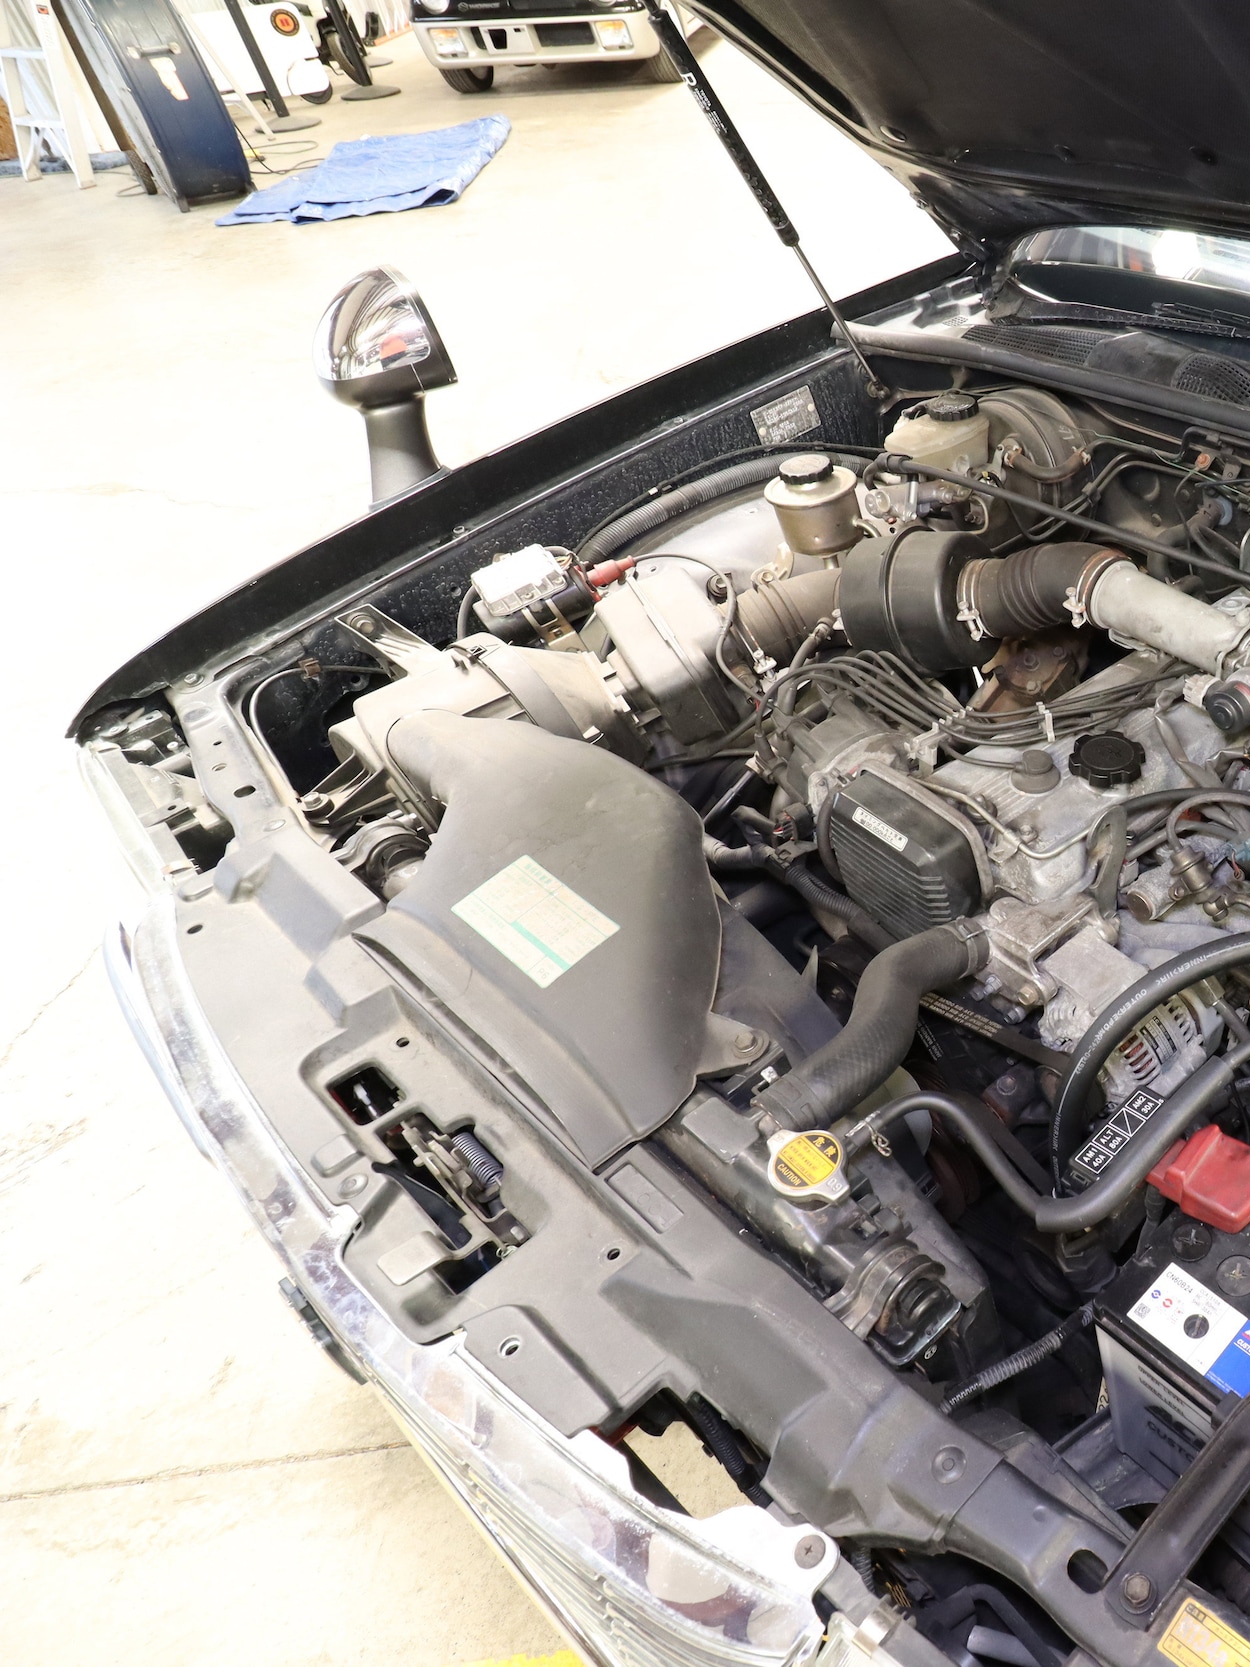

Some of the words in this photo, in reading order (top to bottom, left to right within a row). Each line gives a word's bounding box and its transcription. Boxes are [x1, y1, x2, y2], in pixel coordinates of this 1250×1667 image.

[1132, 1096, 1146, 1109] AM2
[1141, 1102, 1154, 1113] 30A
[1100, 1130, 1114, 1144] ALT
[1108, 1136, 1122, 1149] 80A
[1083, 1148, 1098, 1163] AM1
[1092, 1155, 1106, 1167] 40A
[777, 1164, 801, 1186] CAUTION
[1165, 1271, 1193, 1294] CN60B24
